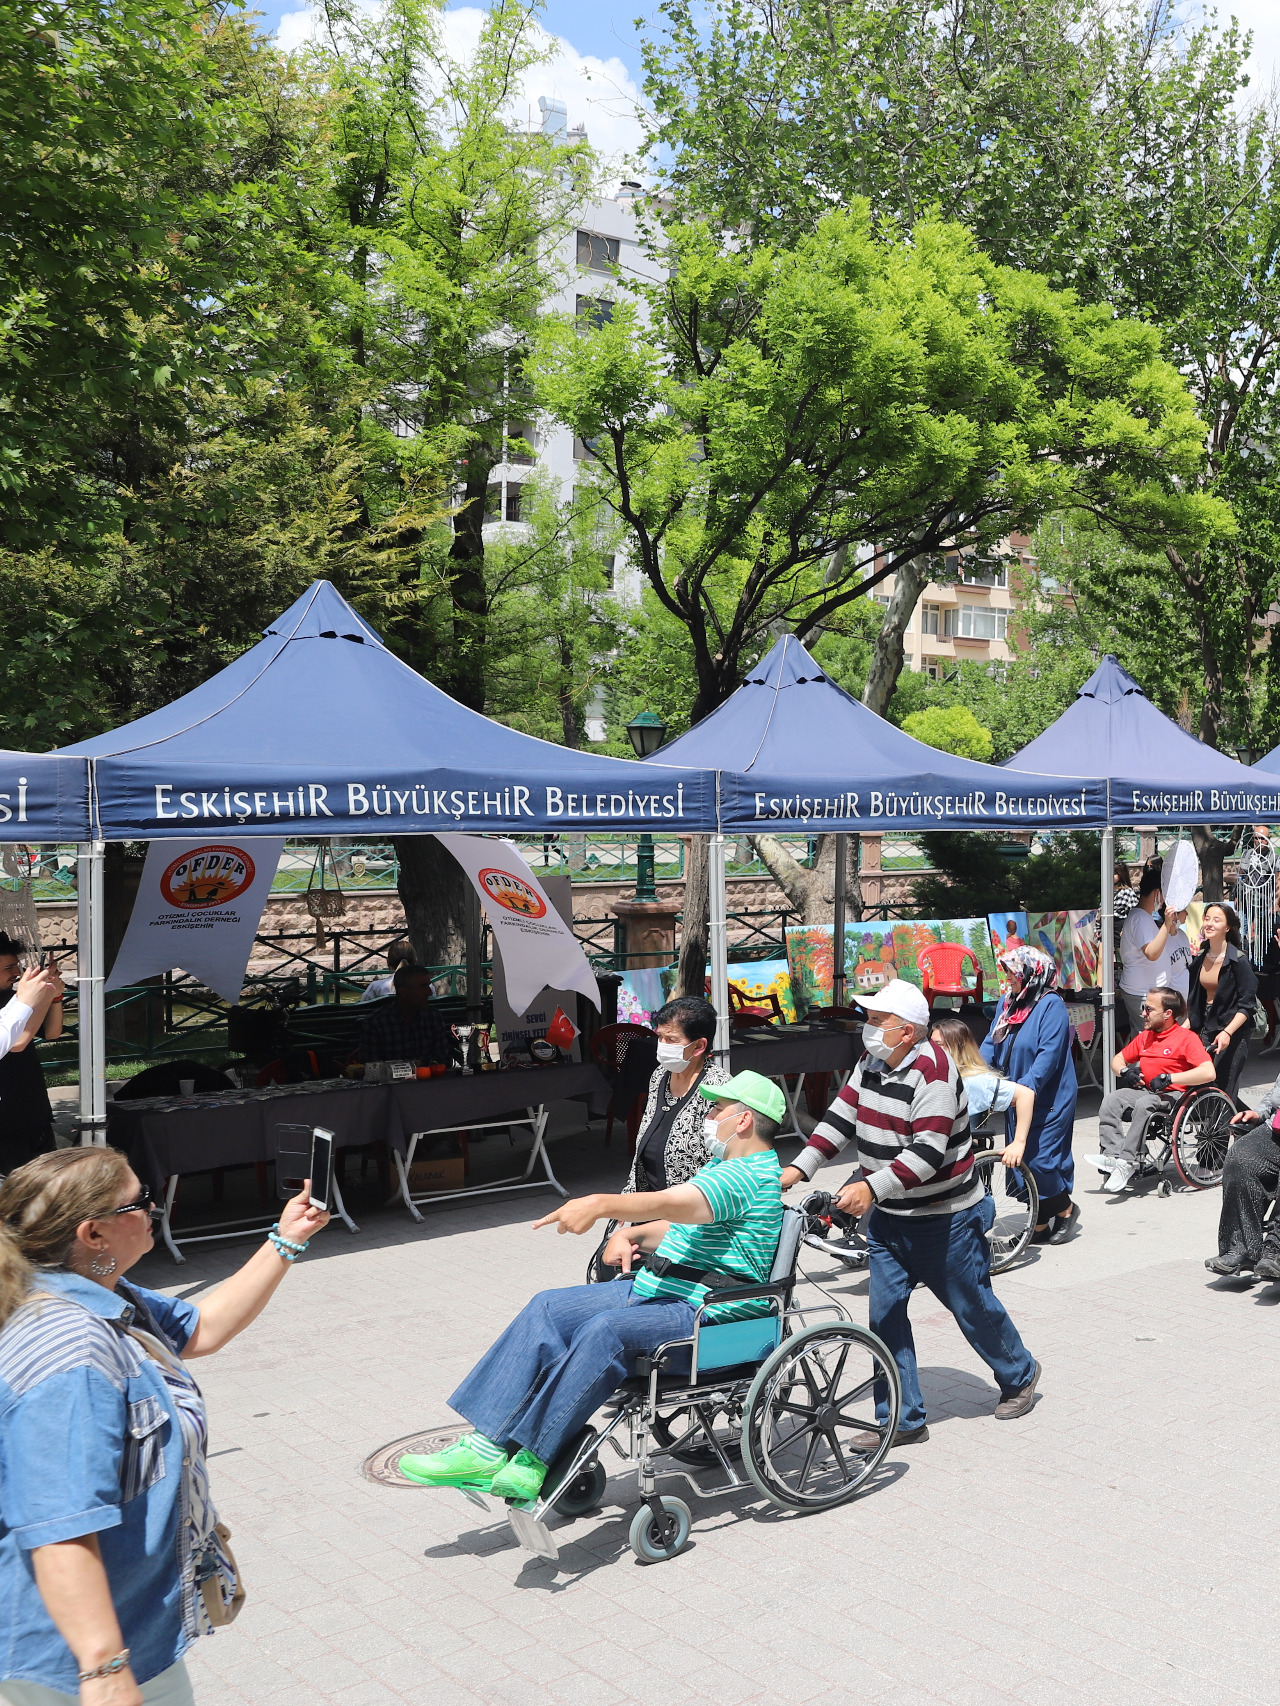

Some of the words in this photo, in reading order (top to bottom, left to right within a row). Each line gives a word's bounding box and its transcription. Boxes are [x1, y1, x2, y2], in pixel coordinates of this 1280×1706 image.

[154, 783, 334, 823] ESKİŞEHİR
[347, 783, 536, 821] BÜYÜKŞEHİR
[545, 782, 685, 817] BELEDİYESİ
[753, 791, 862, 823] ESKİŞEHİR
[869, 790, 989, 821] BÜYÜKŞEHİR
[995, 787, 1087, 816] BELEDİYESİ
[1132, 790, 1205, 816] ESKİŞEHİR
[175, 855, 245, 877] OFDER
[149, 917, 203, 927] FARKINDALIK
[204, 916, 241, 924] DERNEĞİ
[158, 911, 190, 920] OTİZMLİ
[191, 910, 236, 918] ÇOCUKLAR
[526, 1011, 547, 1024] SEVGİ
